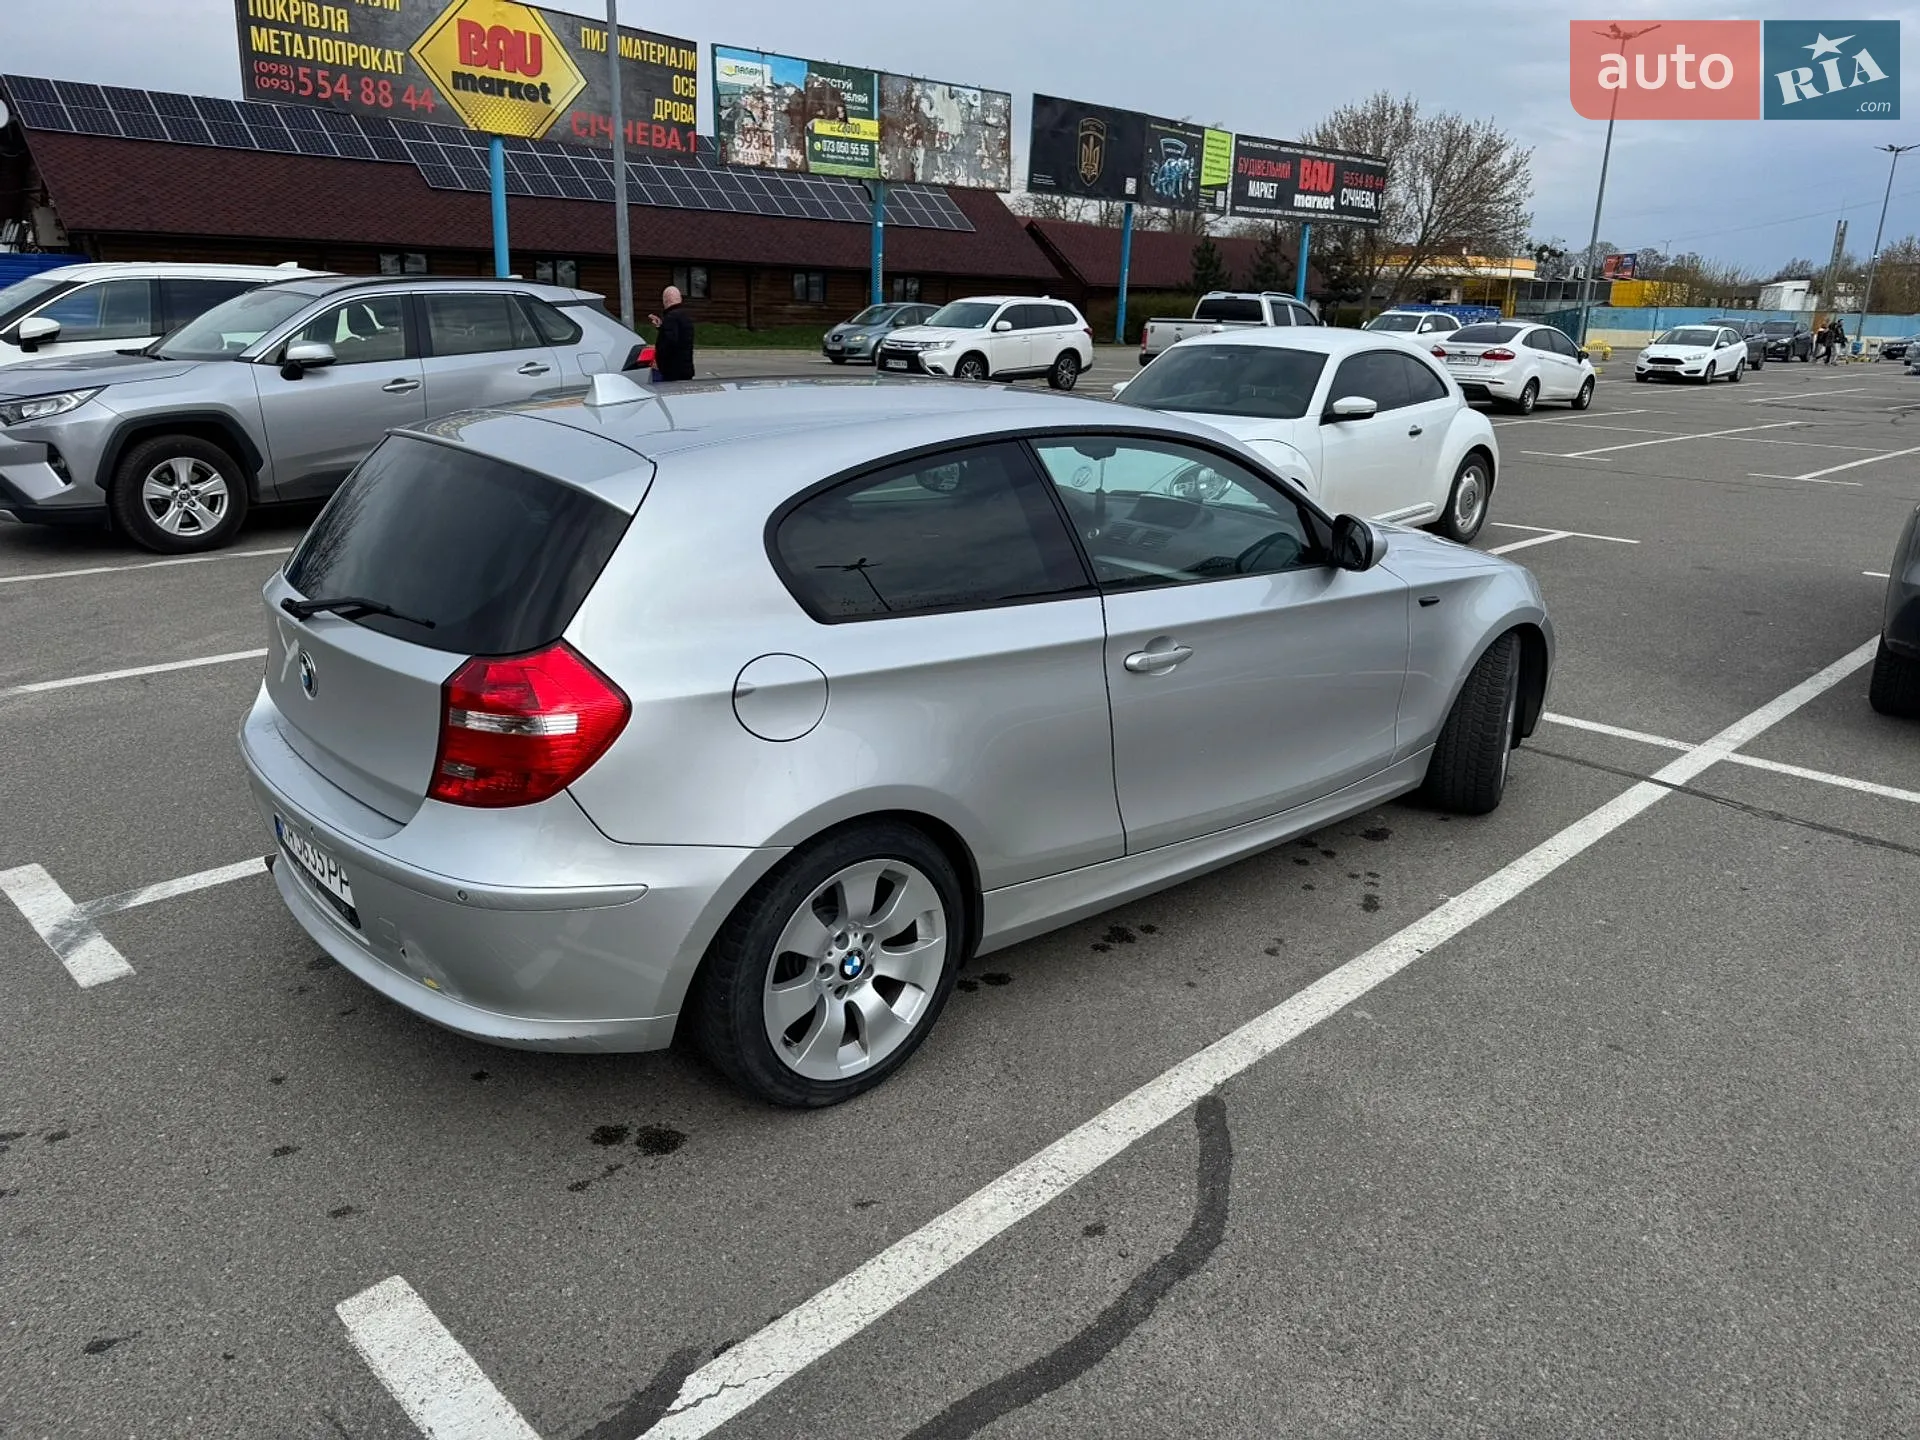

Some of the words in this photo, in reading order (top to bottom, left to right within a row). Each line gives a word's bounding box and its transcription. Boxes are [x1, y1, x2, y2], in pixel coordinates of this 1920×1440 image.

[247, 0, 349, 33] ПОКРІВЛЯ
[250, 25, 405, 75] МЕТАЛОПРОКАТ
[457, 18, 542, 77] BAU
[581, 26, 696, 71] ПИЛМАТЕРІАЛИ
[253, 59, 294, 78] (098)
[298, 67, 352, 101] 554
[360, 76, 393, 108] 88
[402, 84, 437, 114] 44
[255, 75, 296, 94] (093)
[451, 70, 552, 104] market
[673, 74, 696, 98] ОСБ
[652, 98, 696, 125] ДРОВА
[1248, 180, 1278, 200] МАРКЕТ
[1299, 157, 1335, 194] BAU
[1293, 193, 1335, 210] market
